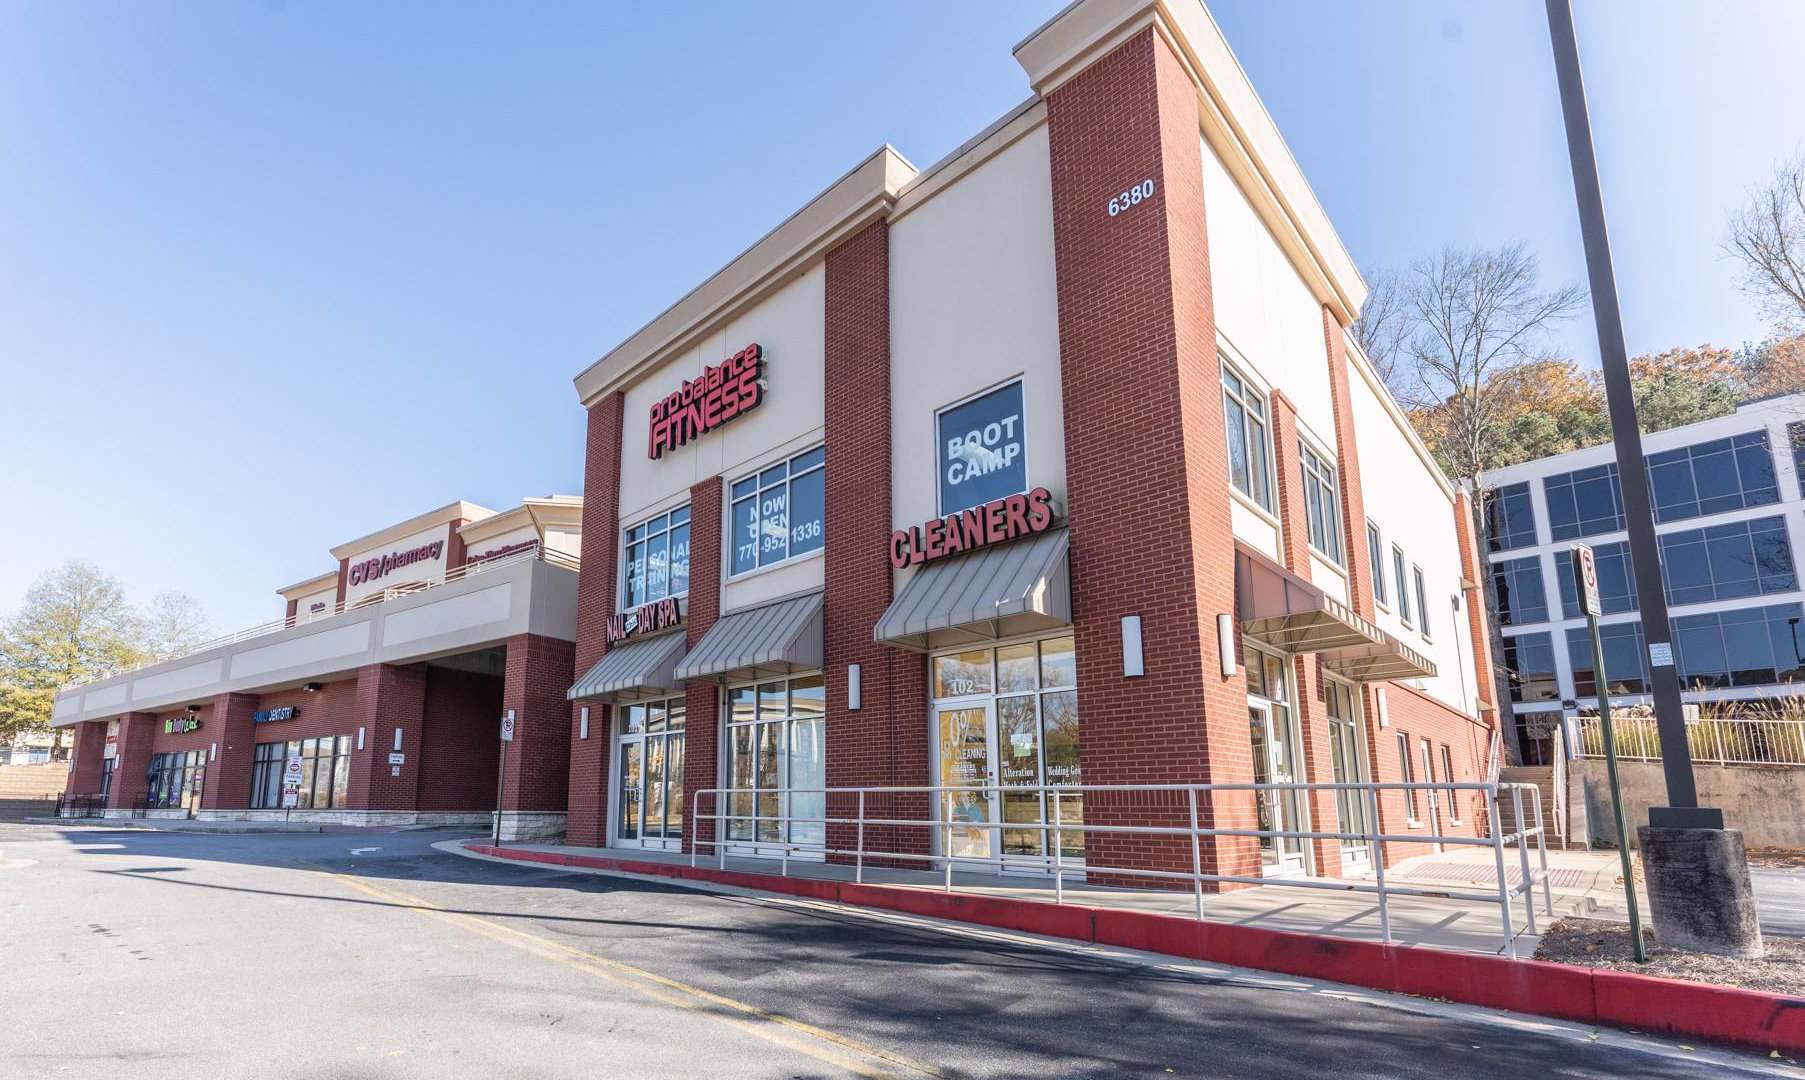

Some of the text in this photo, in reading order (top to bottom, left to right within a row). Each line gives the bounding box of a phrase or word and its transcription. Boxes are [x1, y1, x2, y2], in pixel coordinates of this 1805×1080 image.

[1108, 179, 1155, 217] 6380
[648, 343, 762, 459] pro balance
[652, 366, 762, 460] FITNESS
[947, 414, 1019, 460] BOOT
[947, 442, 1020, 486] CAMP
[750, 494, 786, 522] NOW
[890, 486, 1053, 569] CLEANERS
[738, 519, 821, 562] 770-9521336
[628, 560, 689, 593] TRINNG
[606, 613, 627, 643] NAIL
[638, 602, 658, 634] DAY
[657, 597, 681, 630] SPA
[951, 679, 974, 695] 102
[1004, 767, 1034, 778] Alteration
[1047, 766, 1070, 778] Wedding
